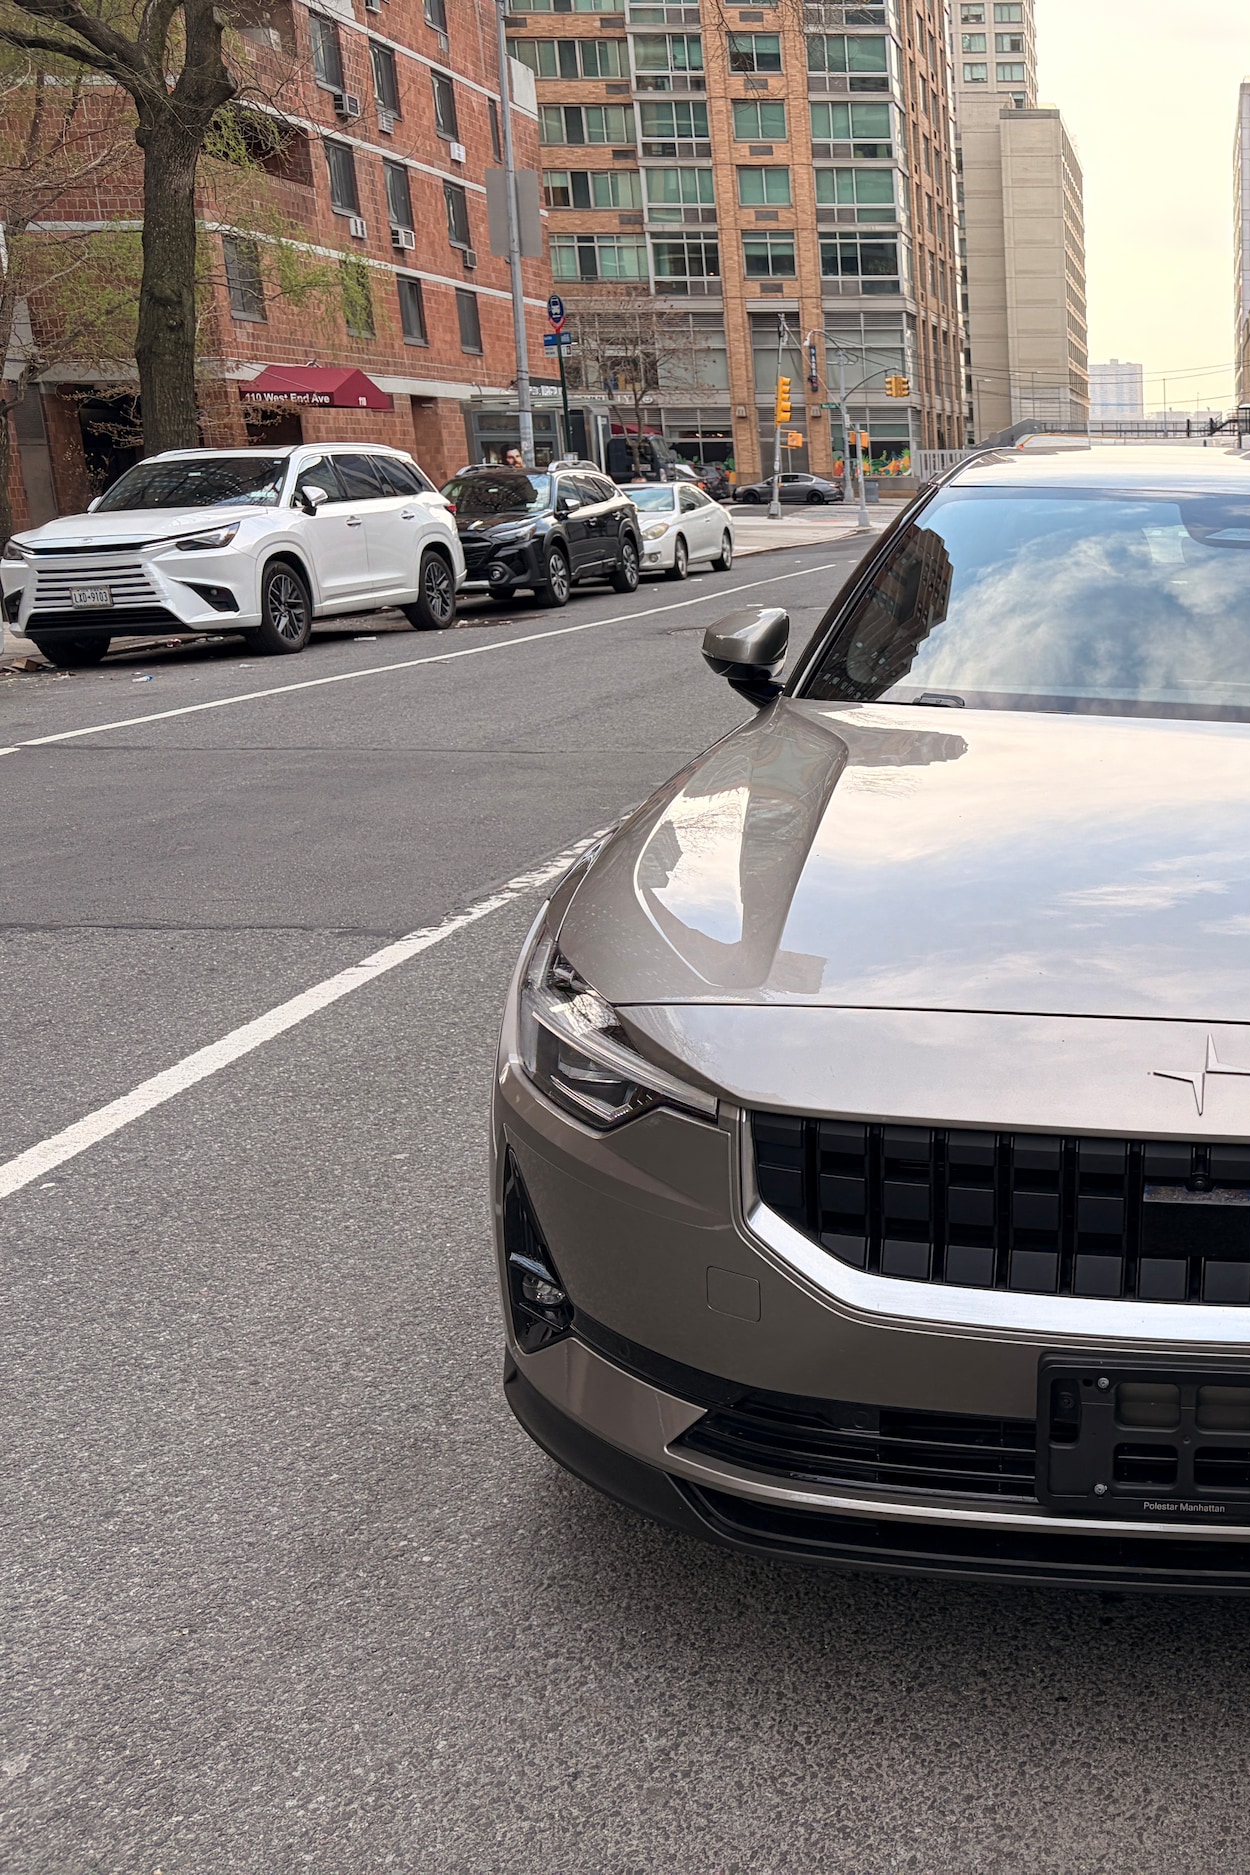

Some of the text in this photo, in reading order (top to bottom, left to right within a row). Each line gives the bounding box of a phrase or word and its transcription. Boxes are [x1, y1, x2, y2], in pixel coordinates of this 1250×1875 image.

[245, 392, 330, 404] 110 West End Ave
[73, 591, 108, 604] LXD-9103
[1143, 1501, 1226, 1514] Polestar Manhattan
